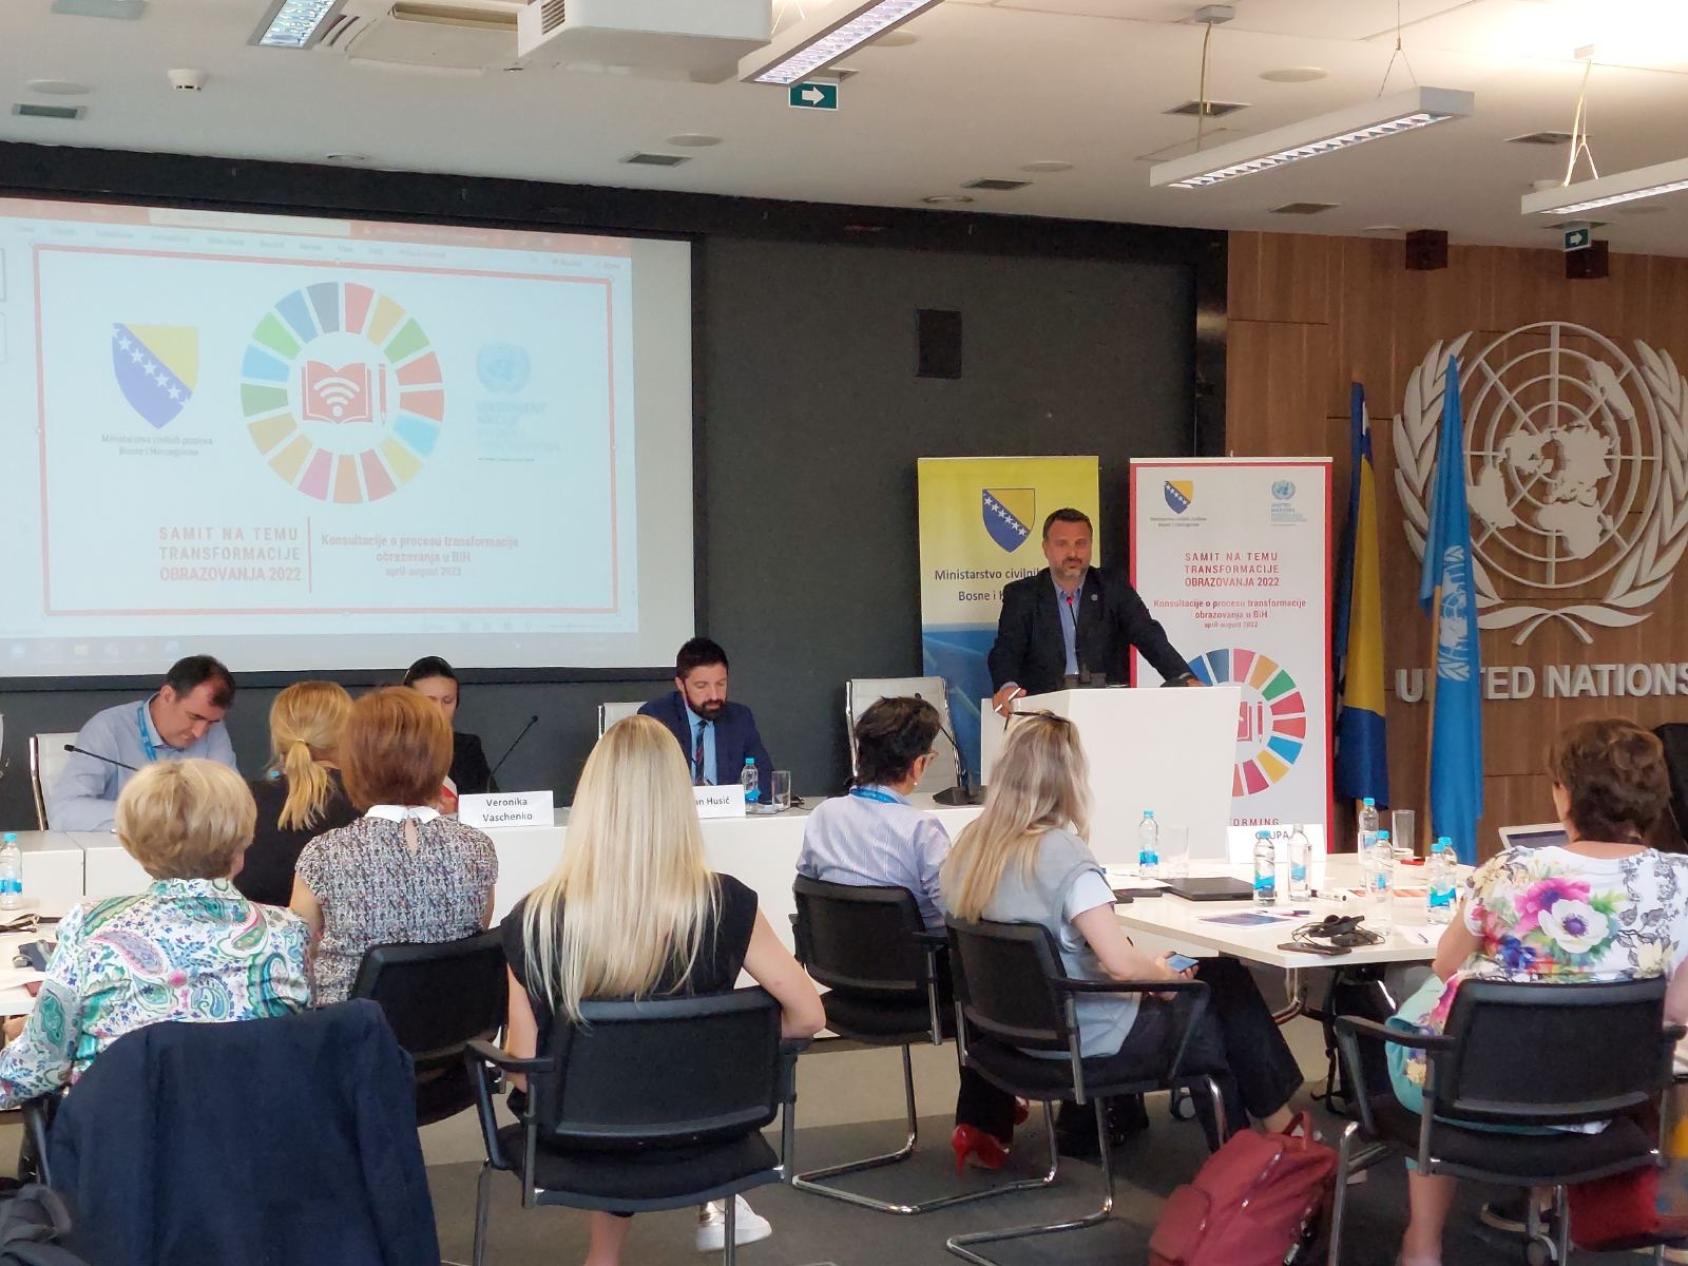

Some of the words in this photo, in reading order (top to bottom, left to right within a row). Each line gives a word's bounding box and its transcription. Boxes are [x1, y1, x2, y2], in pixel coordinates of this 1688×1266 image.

[159, 526, 215, 540] SAMIT
[222, 527, 245, 541] NA
[254, 527, 298, 541] TEMU
[321, 534, 387, 549] Konsultacije
[400, 535, 442, 549] procesu
[159, 546, 302, 561] TRANSFORMACIJE
[376, 552, 441, 564] obrazovanja
[1185, 552, 1220, 561] SAMIT
[1226, 552, 1241, 561] NA
[1247, 552, 1278, 561] TEMU
[159, 566, 267, 581] OBRAZOVANJA
[269, 566, 302, 581] 2022
[935, 568, 1002, 581] Ministarstvo
[1184, 564, 1280, 574] TRANSFORMACIJE
[1184, 577, 1255, 588] OBRAZOVANJA
[1257, 576, 1280, 587] 2022
[959, 591, 991, 601] Bosne
[1153, 599, 1203, 609] Konsultacije
[1212, 601, 1245, 609] procesu
[1247, 598, 1307, 609] transformacije
[1195, 610, 1244, 620] obrazovanja
[1253, 610, 1268, 619] BiH
[486, 797, 528, 807] Veronika
[706, 795, 731, 806] Husić
